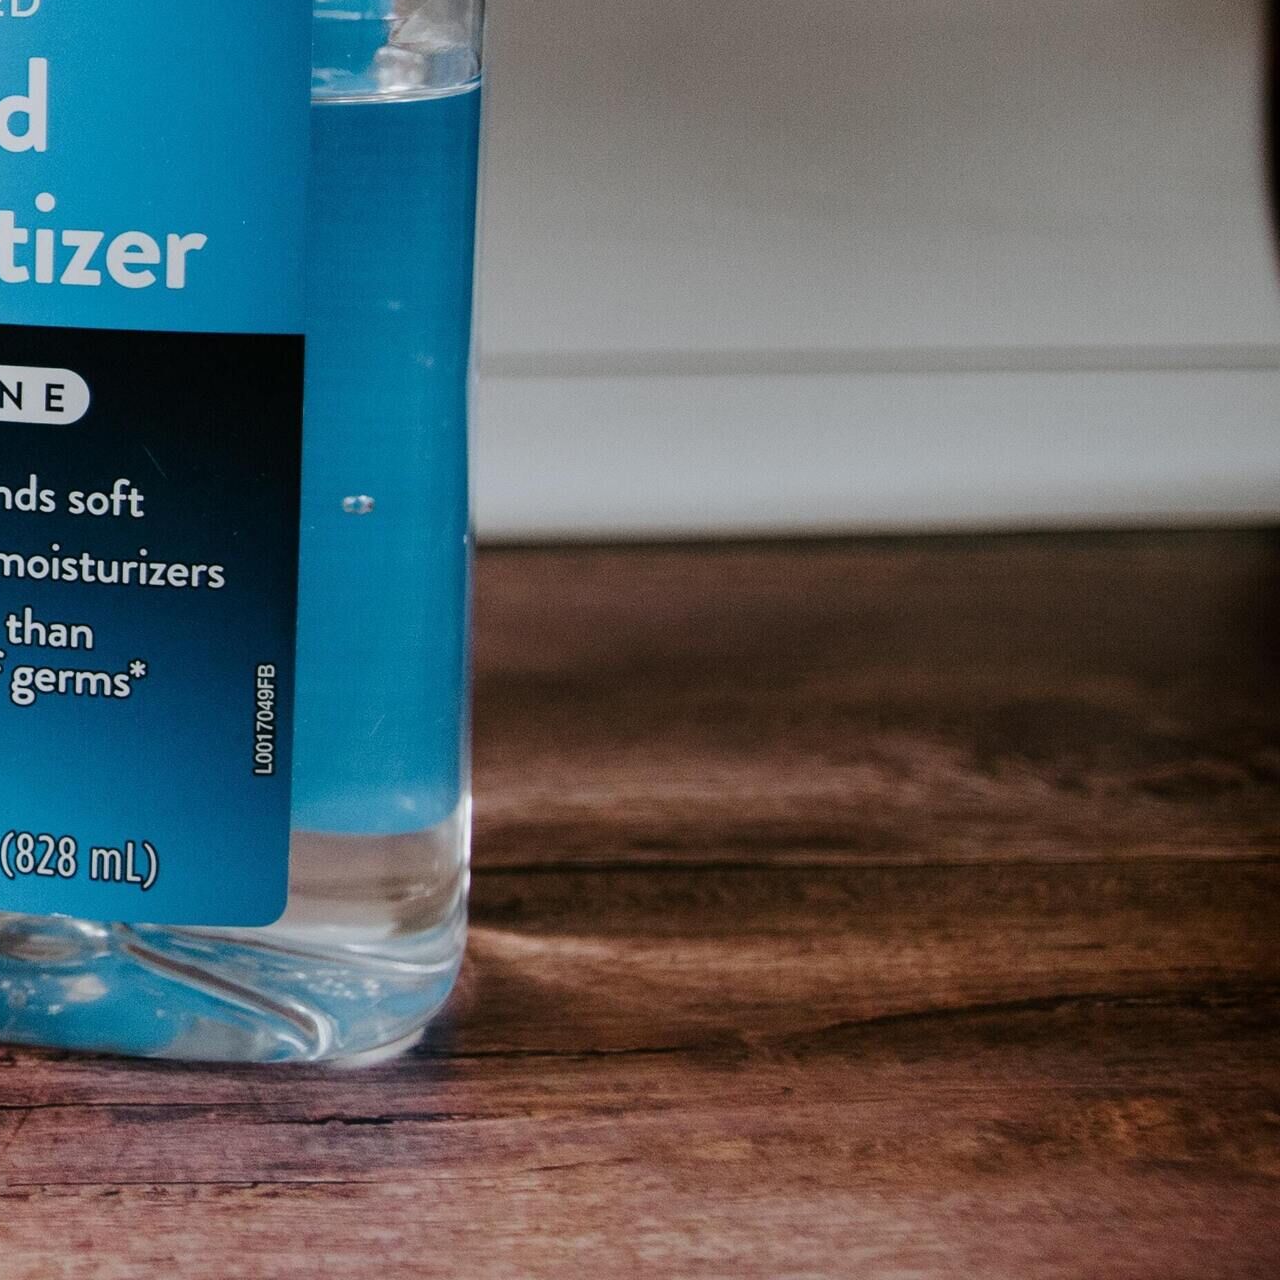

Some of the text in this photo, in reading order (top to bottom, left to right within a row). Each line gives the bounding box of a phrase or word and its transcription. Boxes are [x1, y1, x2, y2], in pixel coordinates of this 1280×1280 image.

[44, 383, 67, 413] E
[68, 478, 145, 518] soft
[6, 608, 94, 651] than
[254, 664, 276, 774] L0017049FB
[0, 830, 77, 879] (828
[89, 840, 160, 890] mL)
